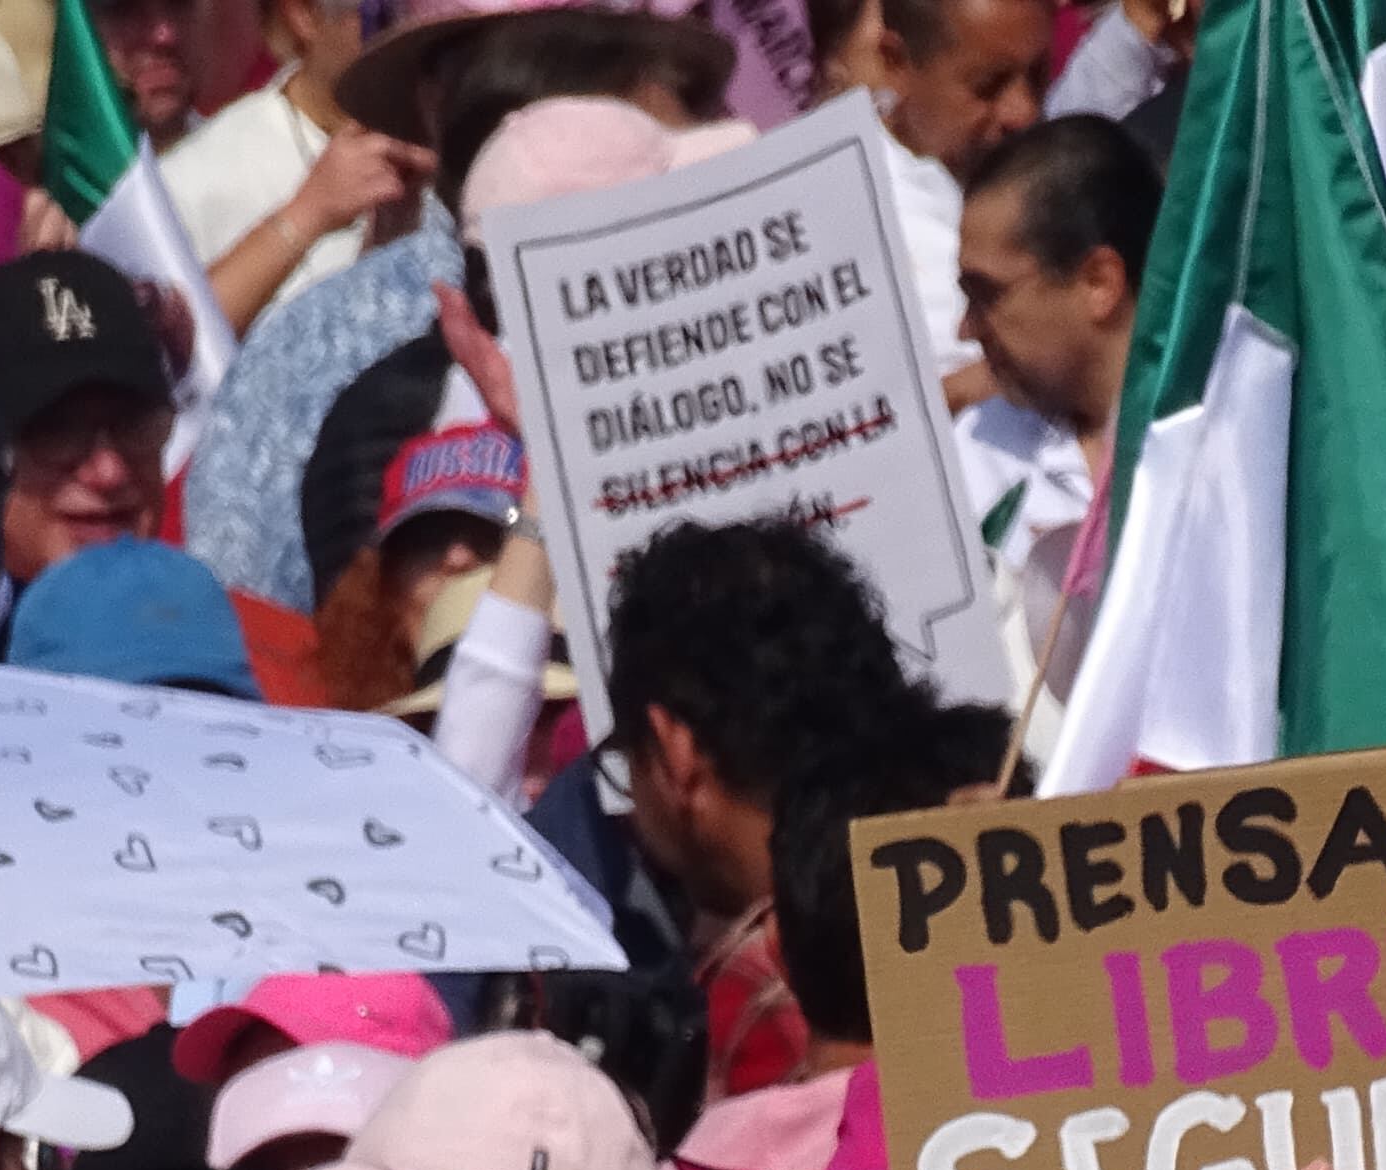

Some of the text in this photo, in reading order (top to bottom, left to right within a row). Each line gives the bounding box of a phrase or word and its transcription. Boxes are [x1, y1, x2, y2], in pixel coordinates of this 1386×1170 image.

[560, 209, 810, 321] LA VERDAD SE
[573, 259, 870, 387] DEFIENDE CON EL
[588, 334, 865, 452] DIÁLOGO. NO SE
[600, 440, 768, 517] SILENCIA
[777, 406, 848, 470] CON
[850, 395, 897, 443] LA
